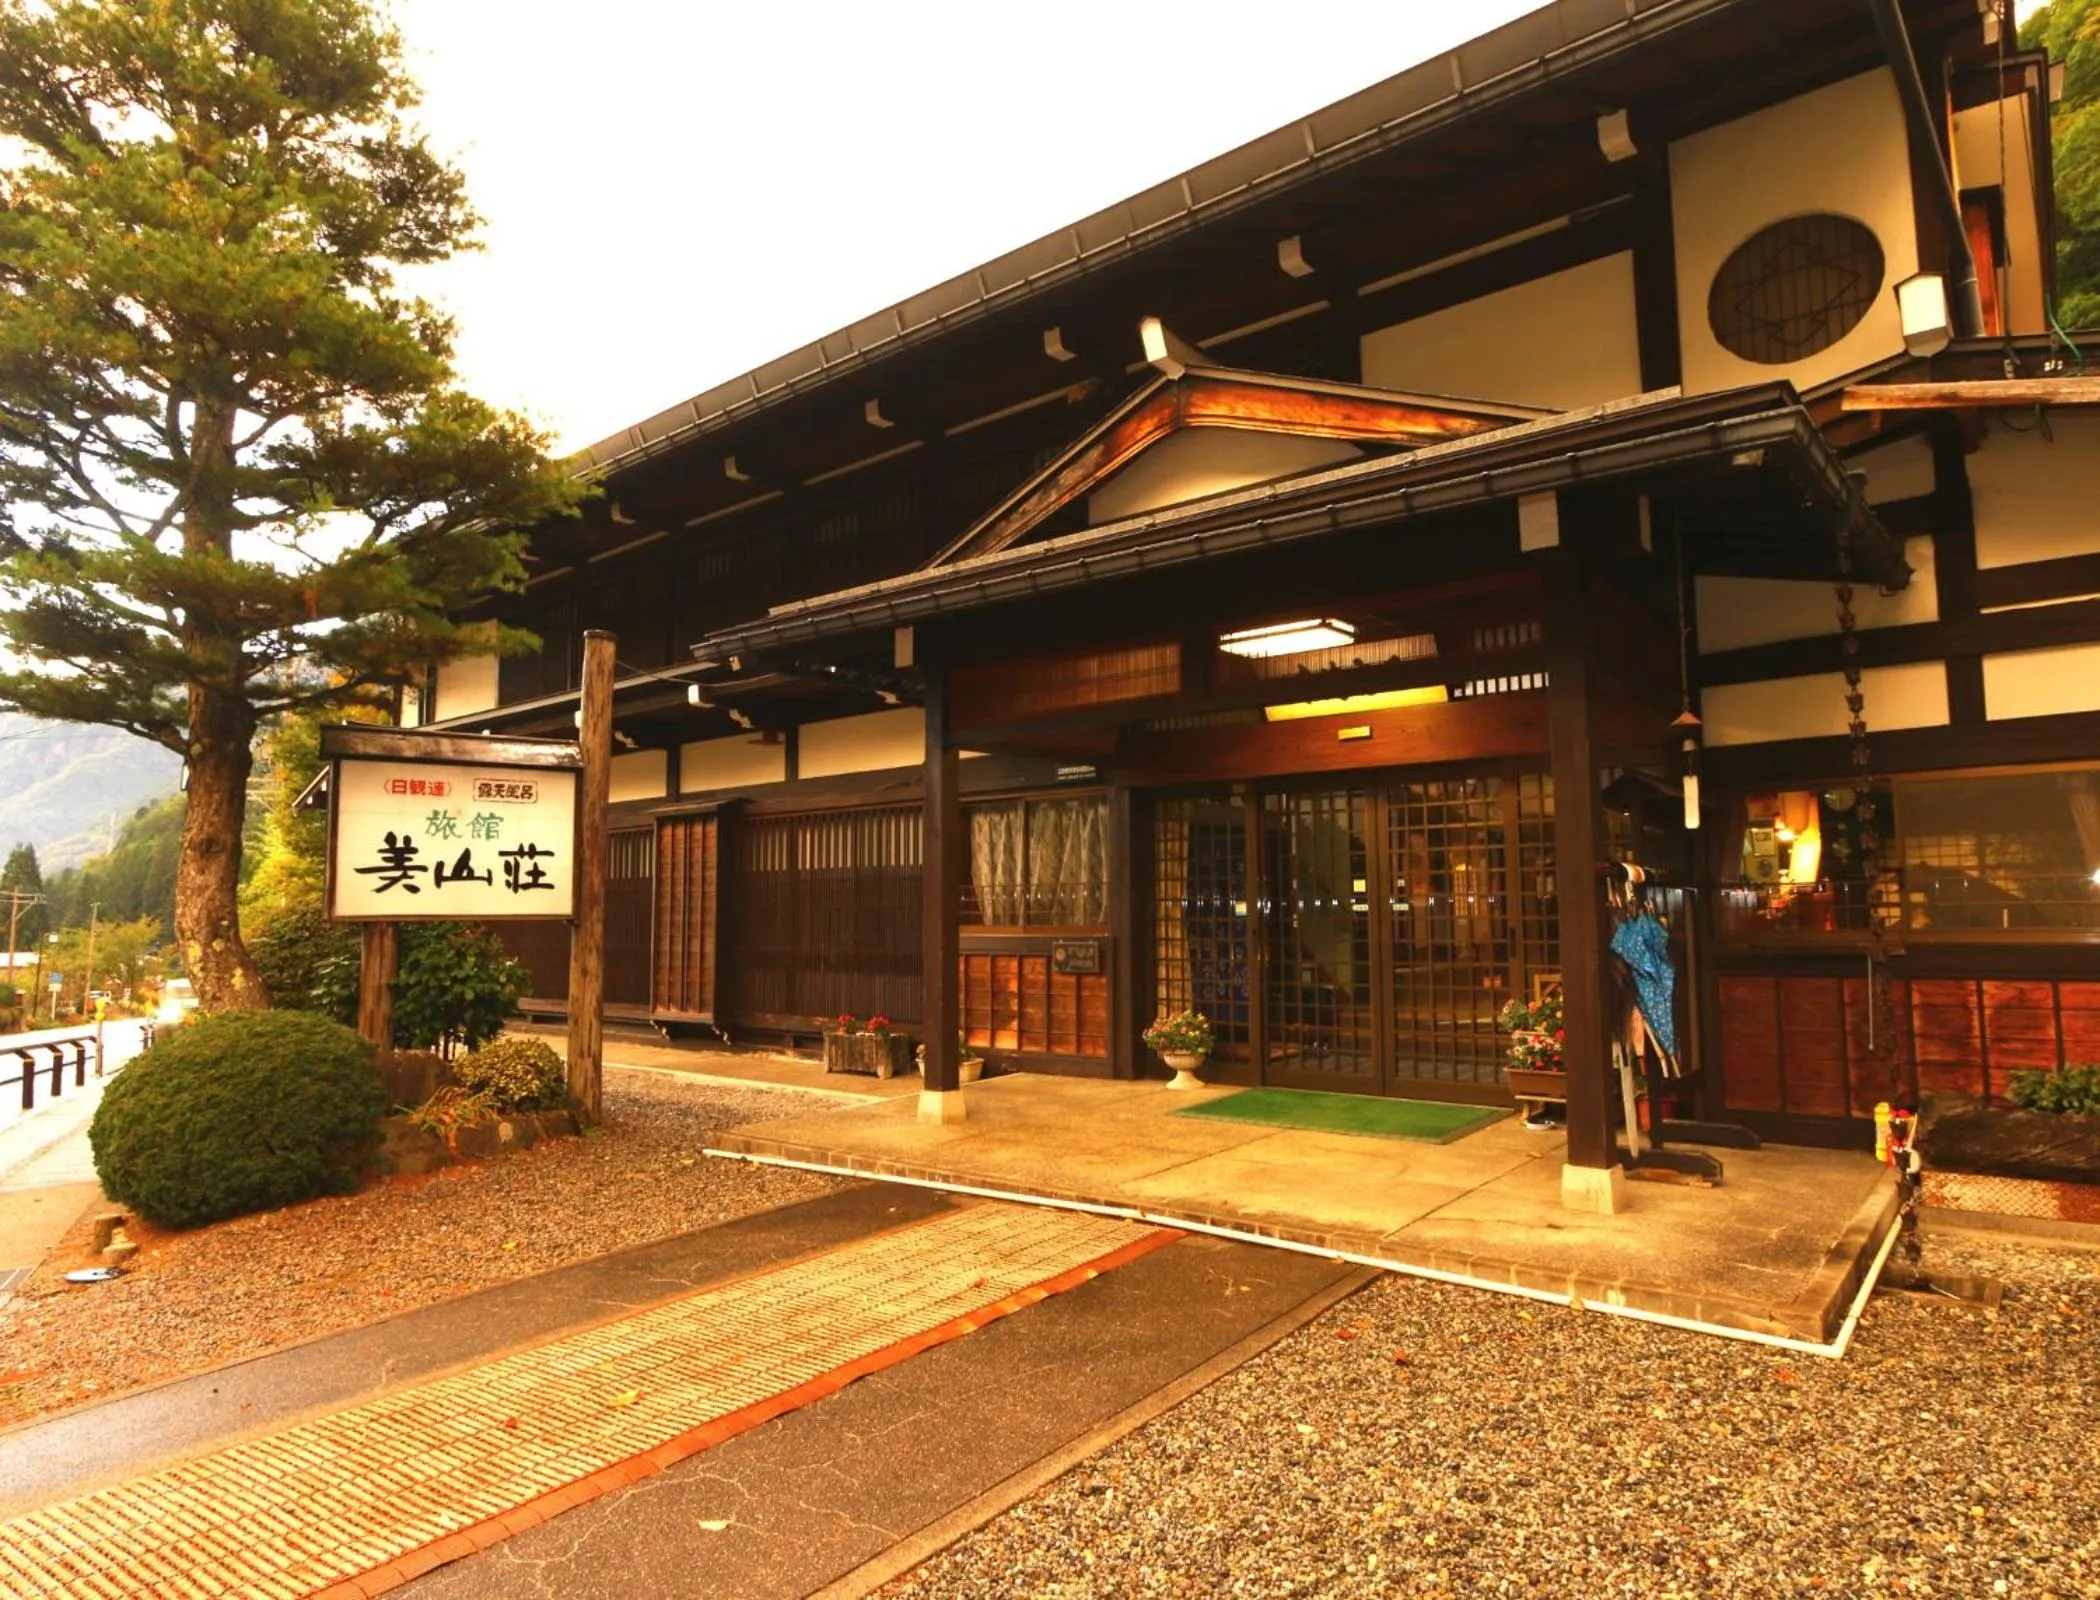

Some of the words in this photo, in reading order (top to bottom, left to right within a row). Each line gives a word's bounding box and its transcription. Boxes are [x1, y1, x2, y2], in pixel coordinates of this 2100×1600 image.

[478, 782, 534, 800] 露天風呂
[424, 809, 504, 841] 旅館
[353, 831, 556, 895] 美山荘
